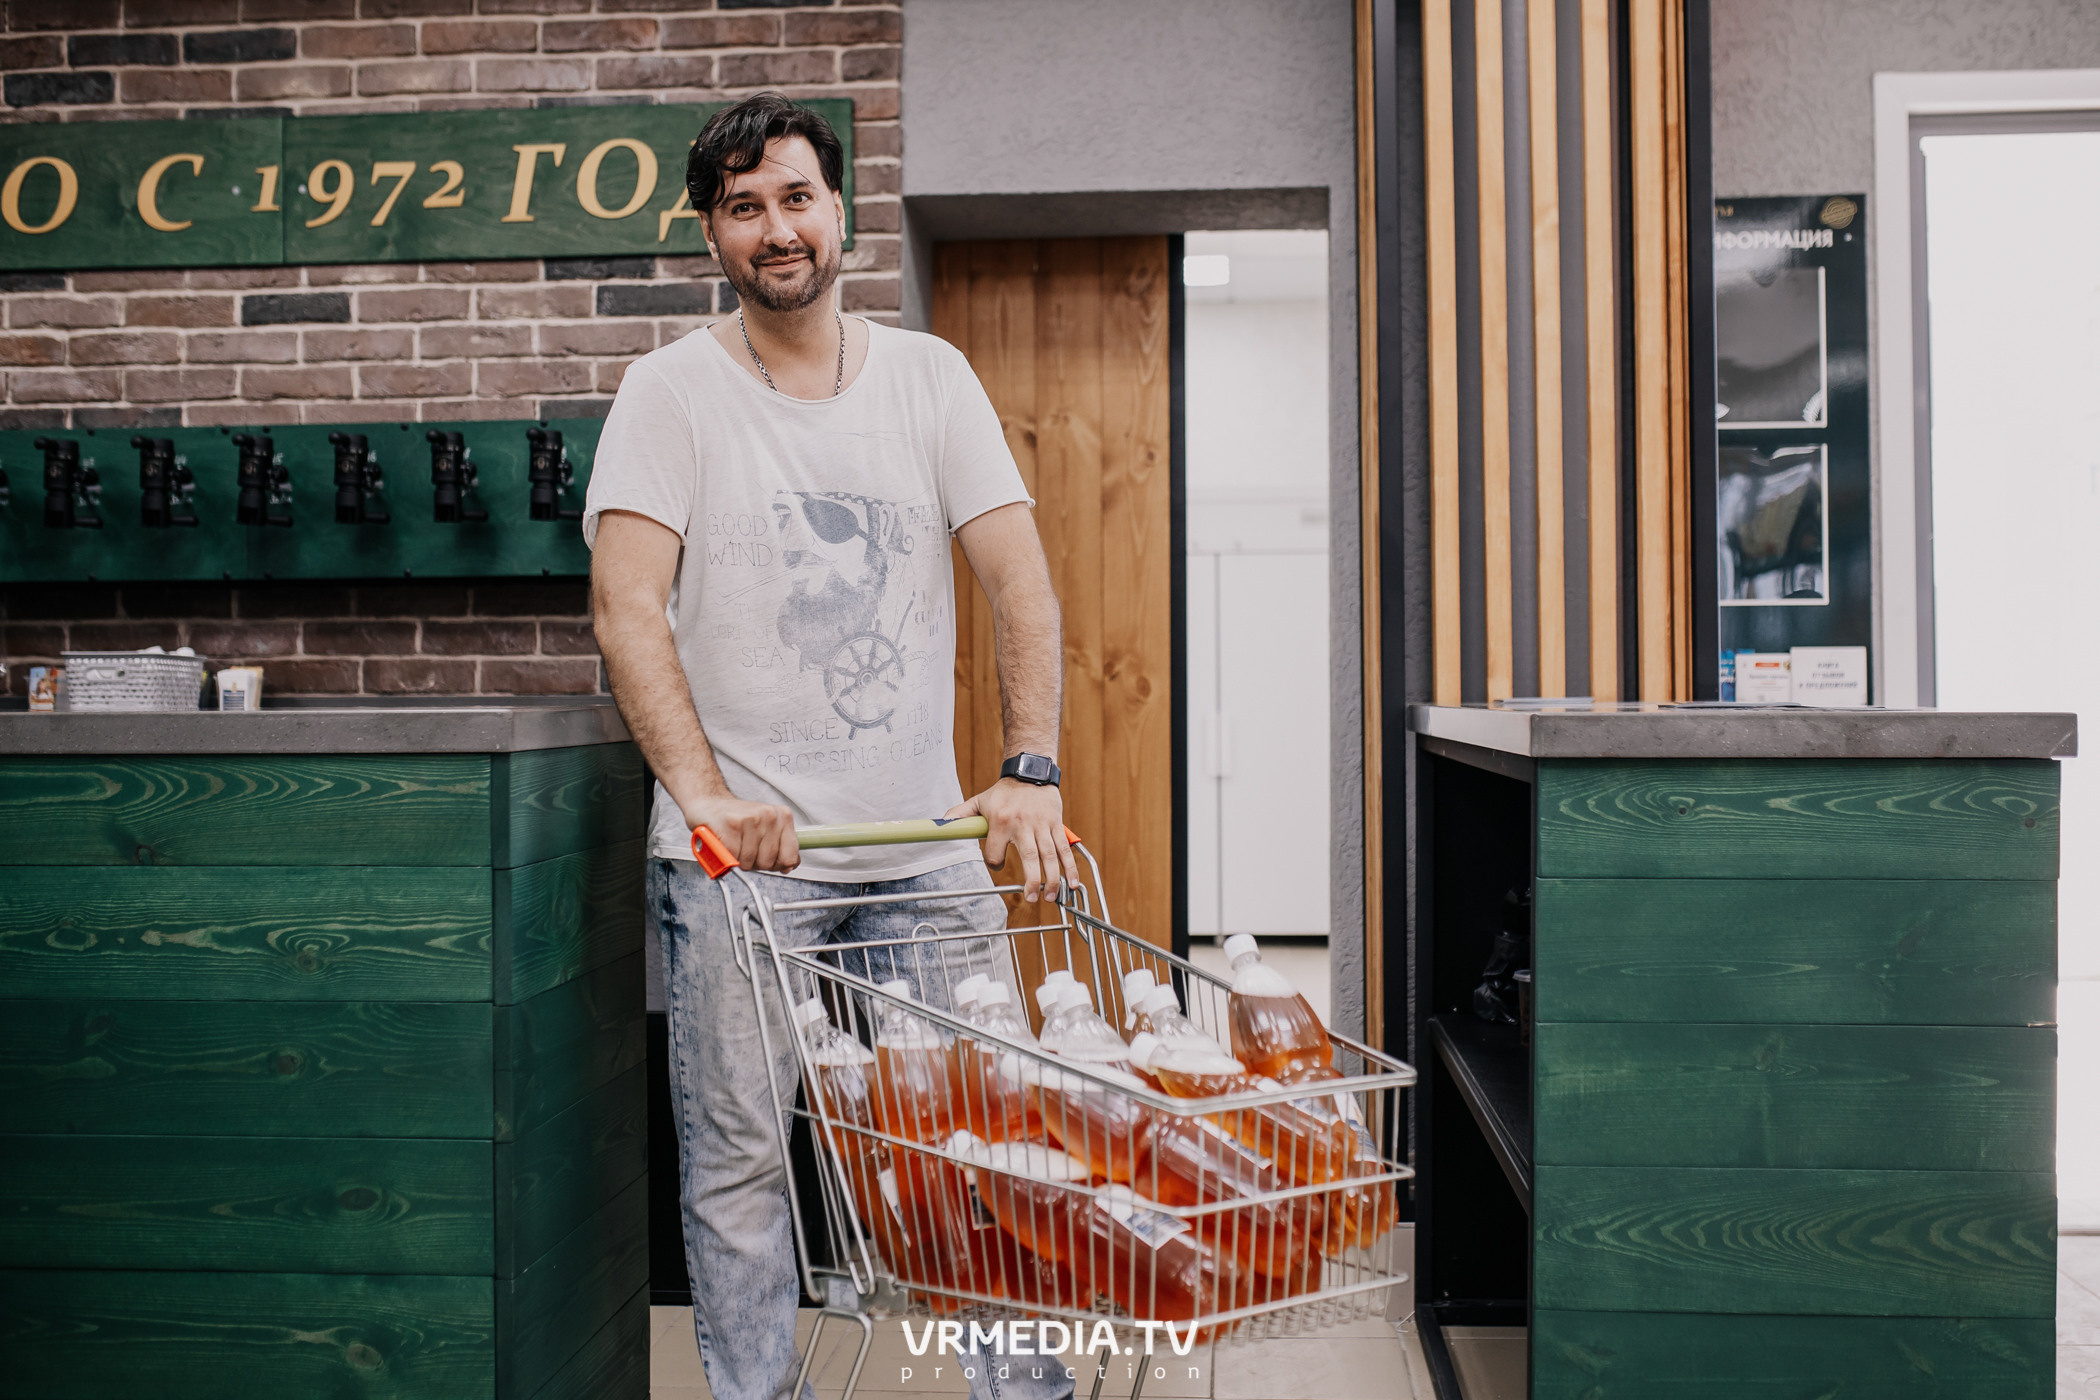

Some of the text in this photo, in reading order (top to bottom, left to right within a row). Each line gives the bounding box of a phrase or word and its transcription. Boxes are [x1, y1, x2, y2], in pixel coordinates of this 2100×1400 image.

[137, 153, 205, 232] С
[251, 158, 467, 229] 1972
[707, 513, 768, 537] GOOD
[707, 542, 774, 567] WIND
[741, 646, 786, 668] SEA
[769, 718, 840, 744] SINCE
[764, 745, 881, 775] CROSSING
